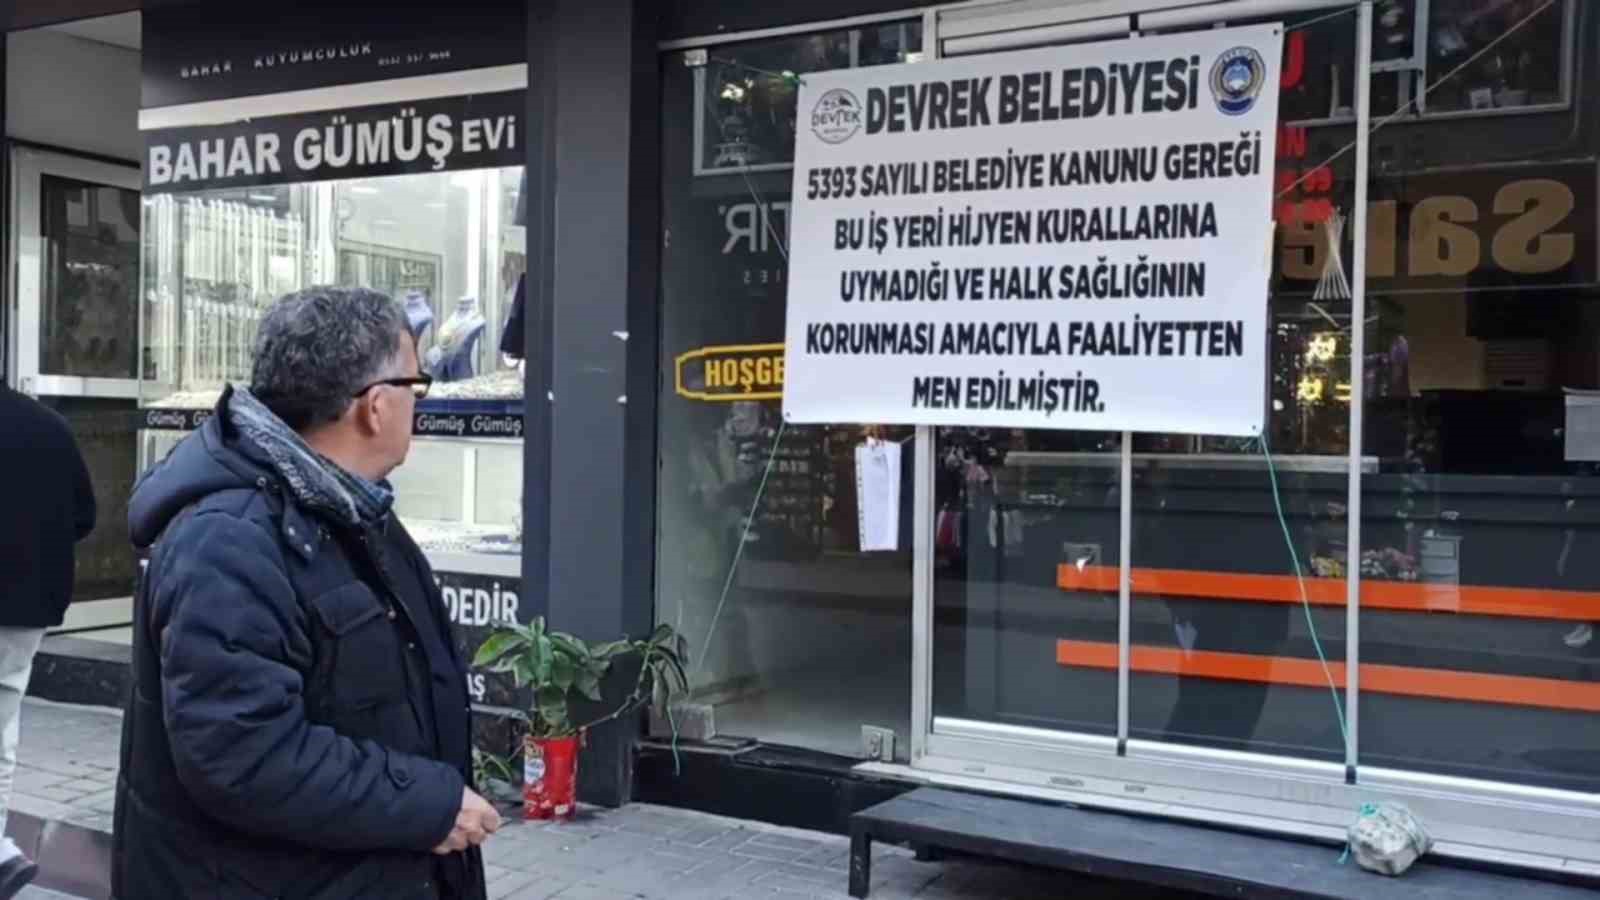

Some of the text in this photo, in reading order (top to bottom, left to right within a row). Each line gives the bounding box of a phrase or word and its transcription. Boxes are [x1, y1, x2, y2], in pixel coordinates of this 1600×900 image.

[254, 43, 371, 68] KUYUMCULUK
[866, 77, 993, 135] DEVREK
[149, 132, 281, 185] BAHAR
[293, 108, 452, 170] GÜMÜŞ
[807, 165, 857, 200] 5393
[860, 161, 929, 198] SAYILI
[932, 147, 1044, 193] BELEDİYE
[1049, 146, 1158, 187] KANUNU
[1163, 130, 1262, 181] GEREĞİ
[834, 202, 1219, 255] BU İŞ YERİ HİJYEN KURALLARINA
[840, 255, 1206, 303] UYMADIĞI VE HALK SAĞLIĞININ
[806, 313, 1244, 357] KORUNMASI AMACIYLA FAALİYETTEN
[911, 369, 1105, 418] MEN EDİLMİŞTİR.
[147, 410, 185, 430] Gümüş
[416, 414, 522, 437] Gümüş Gümüş
[434, 578, 519, 627] DEDİR
